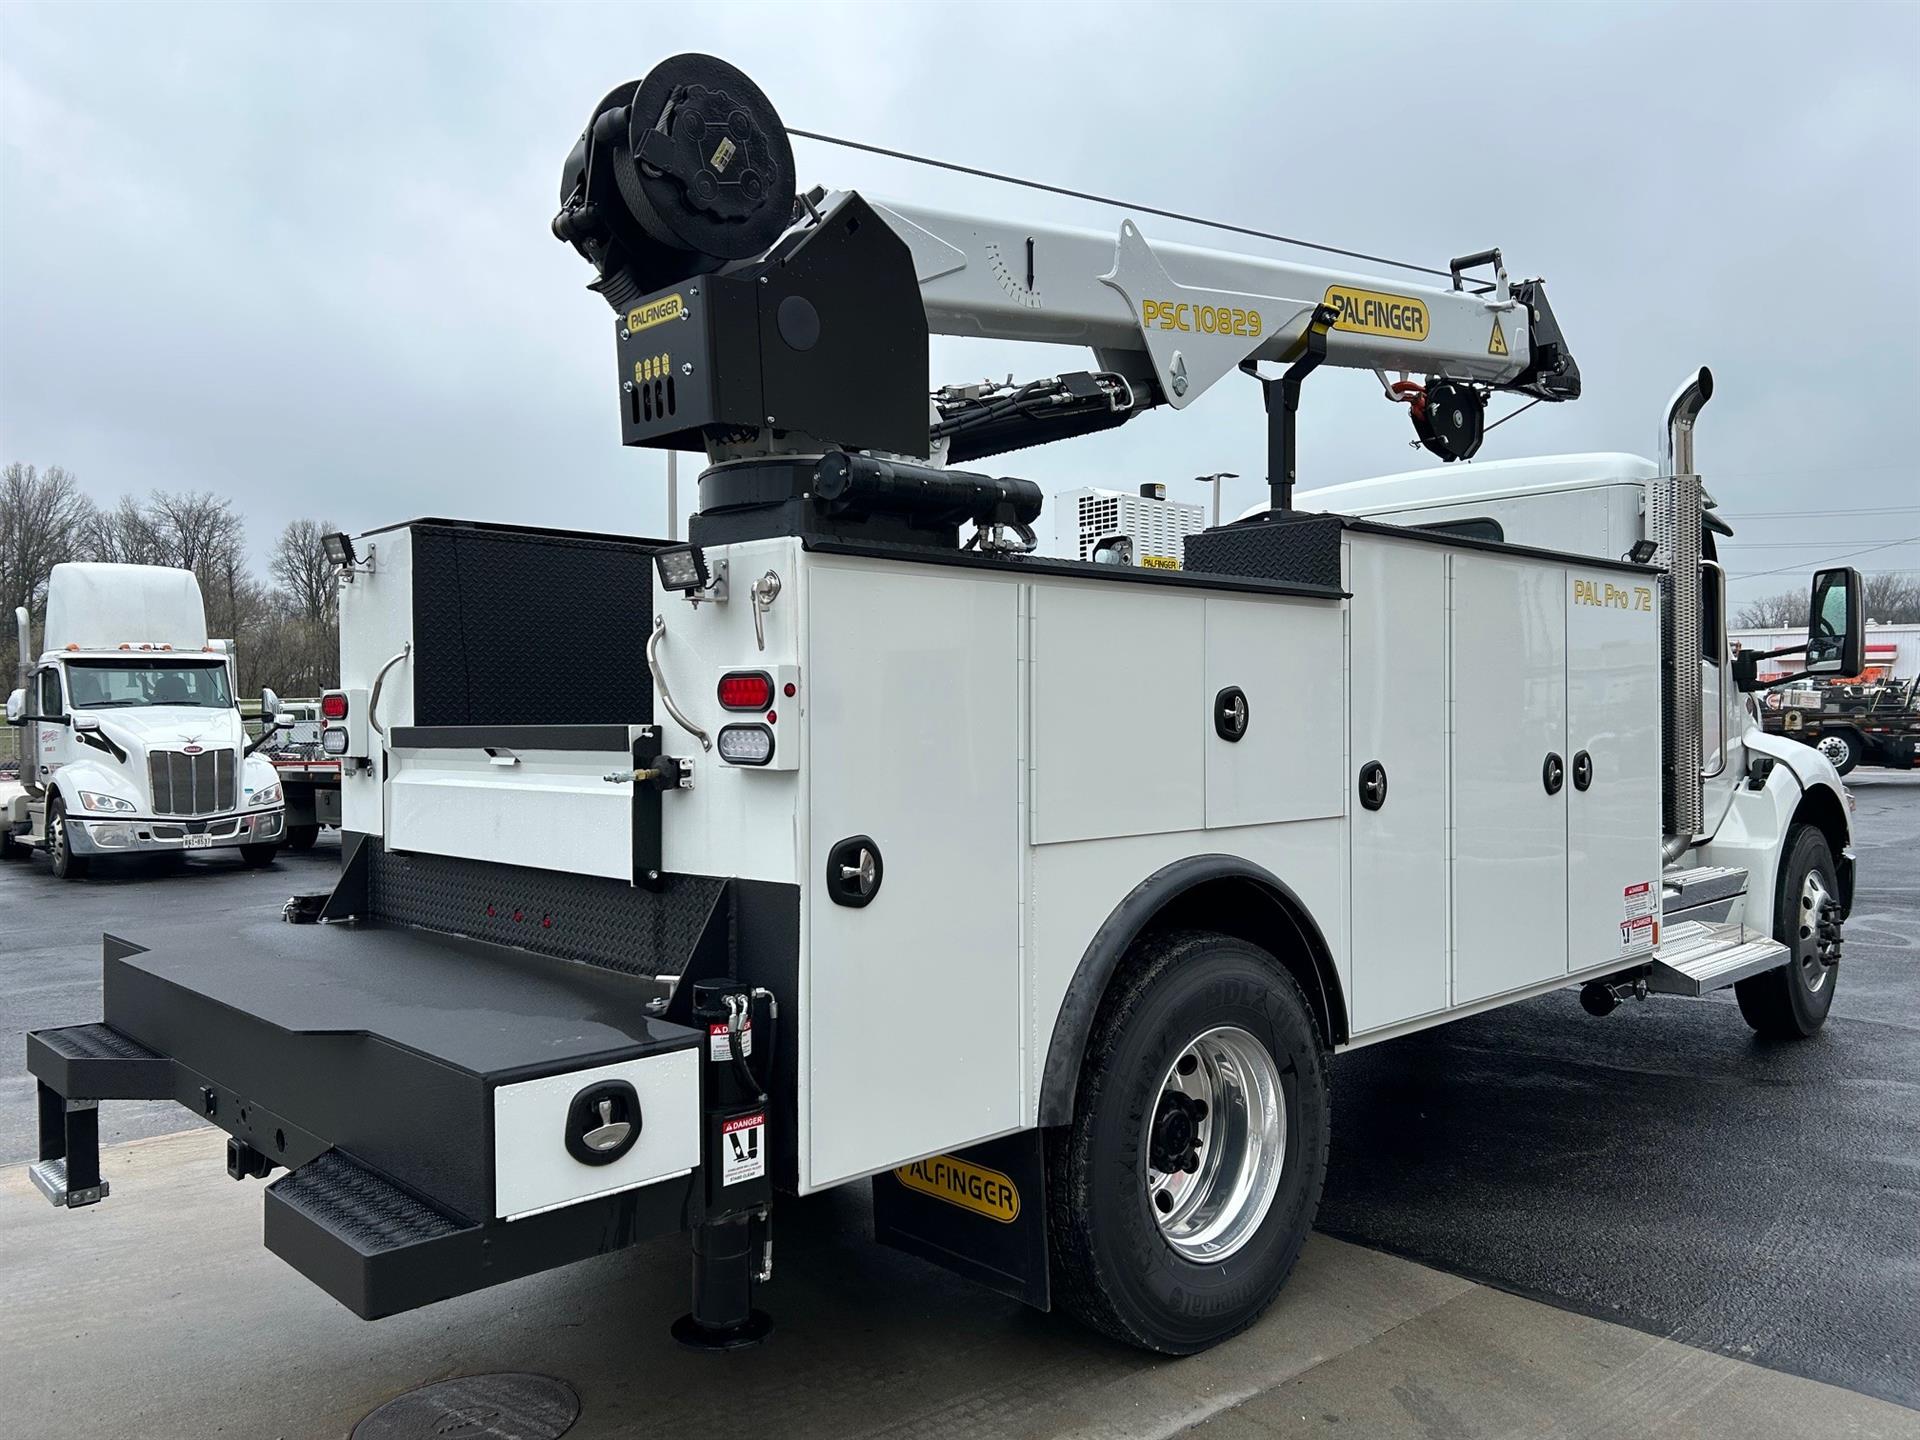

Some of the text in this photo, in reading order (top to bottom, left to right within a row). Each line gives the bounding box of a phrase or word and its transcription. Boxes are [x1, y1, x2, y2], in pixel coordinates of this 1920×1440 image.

[631, 300, 679, 330] PALFINGER
[1332, 294, 1424, 334] PALFINGER
[1143, 558, 1176, 569] PALFINGER
[1574, 579, 1652, 612] PAL Pro 72
[733, 1116, 763, 1130] DANGER
[898, 1158, 1014, 1212] ALFINGER
